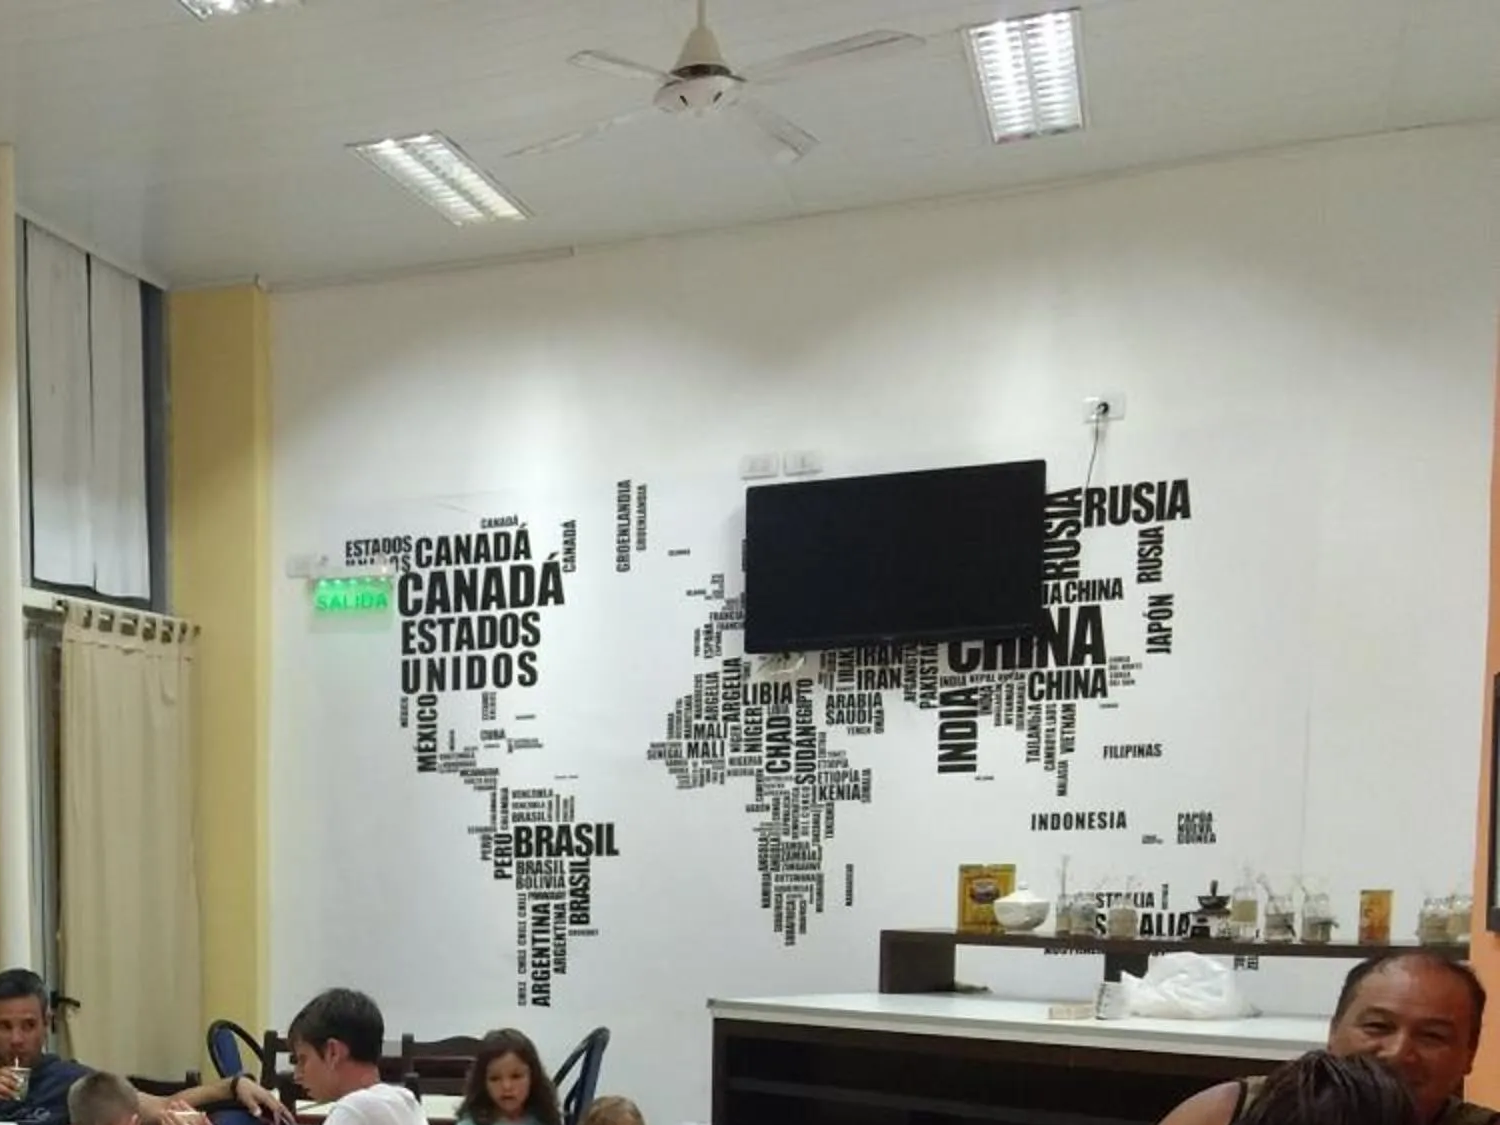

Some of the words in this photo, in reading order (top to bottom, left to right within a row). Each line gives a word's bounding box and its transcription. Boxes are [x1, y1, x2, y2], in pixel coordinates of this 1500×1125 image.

[480, 514, 519, 529] CANADÁ
[616, 479, 631, 572] GROENLANDIA
[1083, 478, 1191, 528] RUSIA
[345, 535, 413, 558] ESTADOS
[415, 522, 532, 569] CANADÁ
[1043, 486, 1082, 581] RUSIA
[1136, 525, 1165, 584] RUSIA
[315, 592, 389, 611] SALIDA
[398, 552, 565, 617] CANADÁ
[1064, 577, 1124, 604] CHINA
[401, 611, 541, 656] ESTADOS
[1142, 593, 1174, 655] JAPÓN
[401, 650, 539, 694] UNIDOS
[722, 657, 741, 722] ARGELIA
[743, 682, 793, 705] LIBIA
[857, 668, 902, 690] IRAN
[1028, 668, 1108, 701] CHINA
[705, 672, 719, 721] ARGELIA
[796, 678, 813, 724] EGIPTO
[826, 692, 883, 709] ARABIA
[414, 693, 438, 772] MÉXICO
[687, 740, 725, 758] MALI
[765, 716, 791, 773] CHAD
[938, 686, 979, 773] INDIA
[1103, 743, 1163, 760] FILIPINAS
[819, 784, 861, 800] KENIA
[514, 822, 620, 858] BRASIL
[1030, 810, 1128, 831] INDONESIA
[516, 860, 565, 875] BRASIL
[516, 875, 565, 890] BOLIVIA
[569, 856, 590, 925] BRASIL
[531, 902, 551, 1007] ARGENTINA
[554, 903, 567, 974] ARGENTINA
